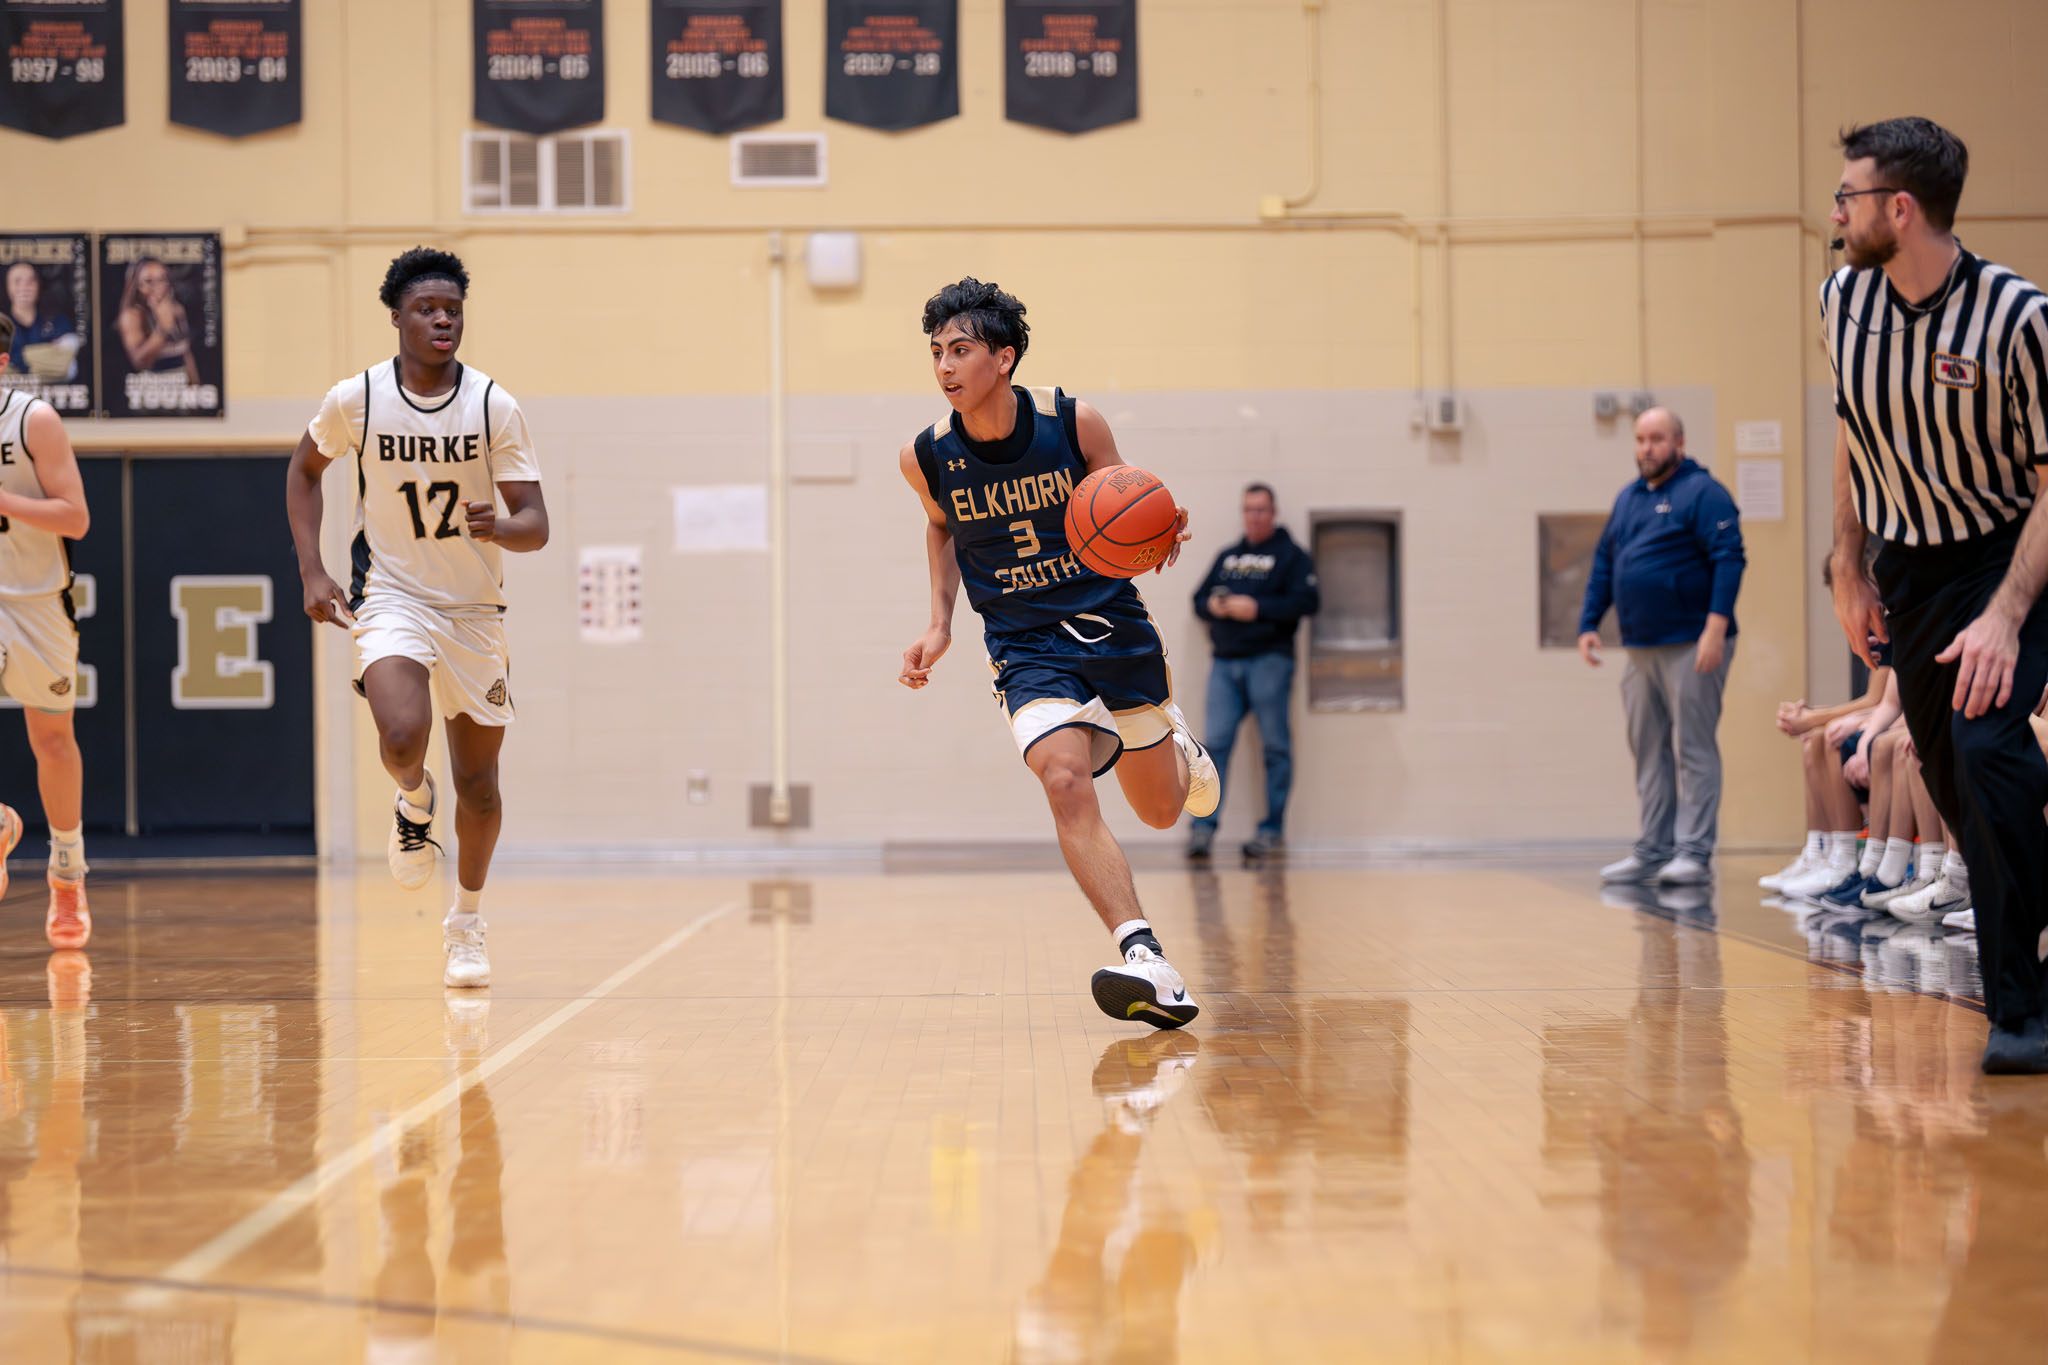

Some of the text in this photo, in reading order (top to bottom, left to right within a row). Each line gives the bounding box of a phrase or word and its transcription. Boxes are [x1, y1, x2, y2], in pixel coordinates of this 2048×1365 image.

[12, 58, 56, 82] 1997
[377, 433, 479, 462] BURKE
[397, 480, 461, 539] 12
[951, 467, 1074, 522] ELKHORN
[1009, 519, 1041, 559] 3
[994, 551, 1081, 594] SOUTH
